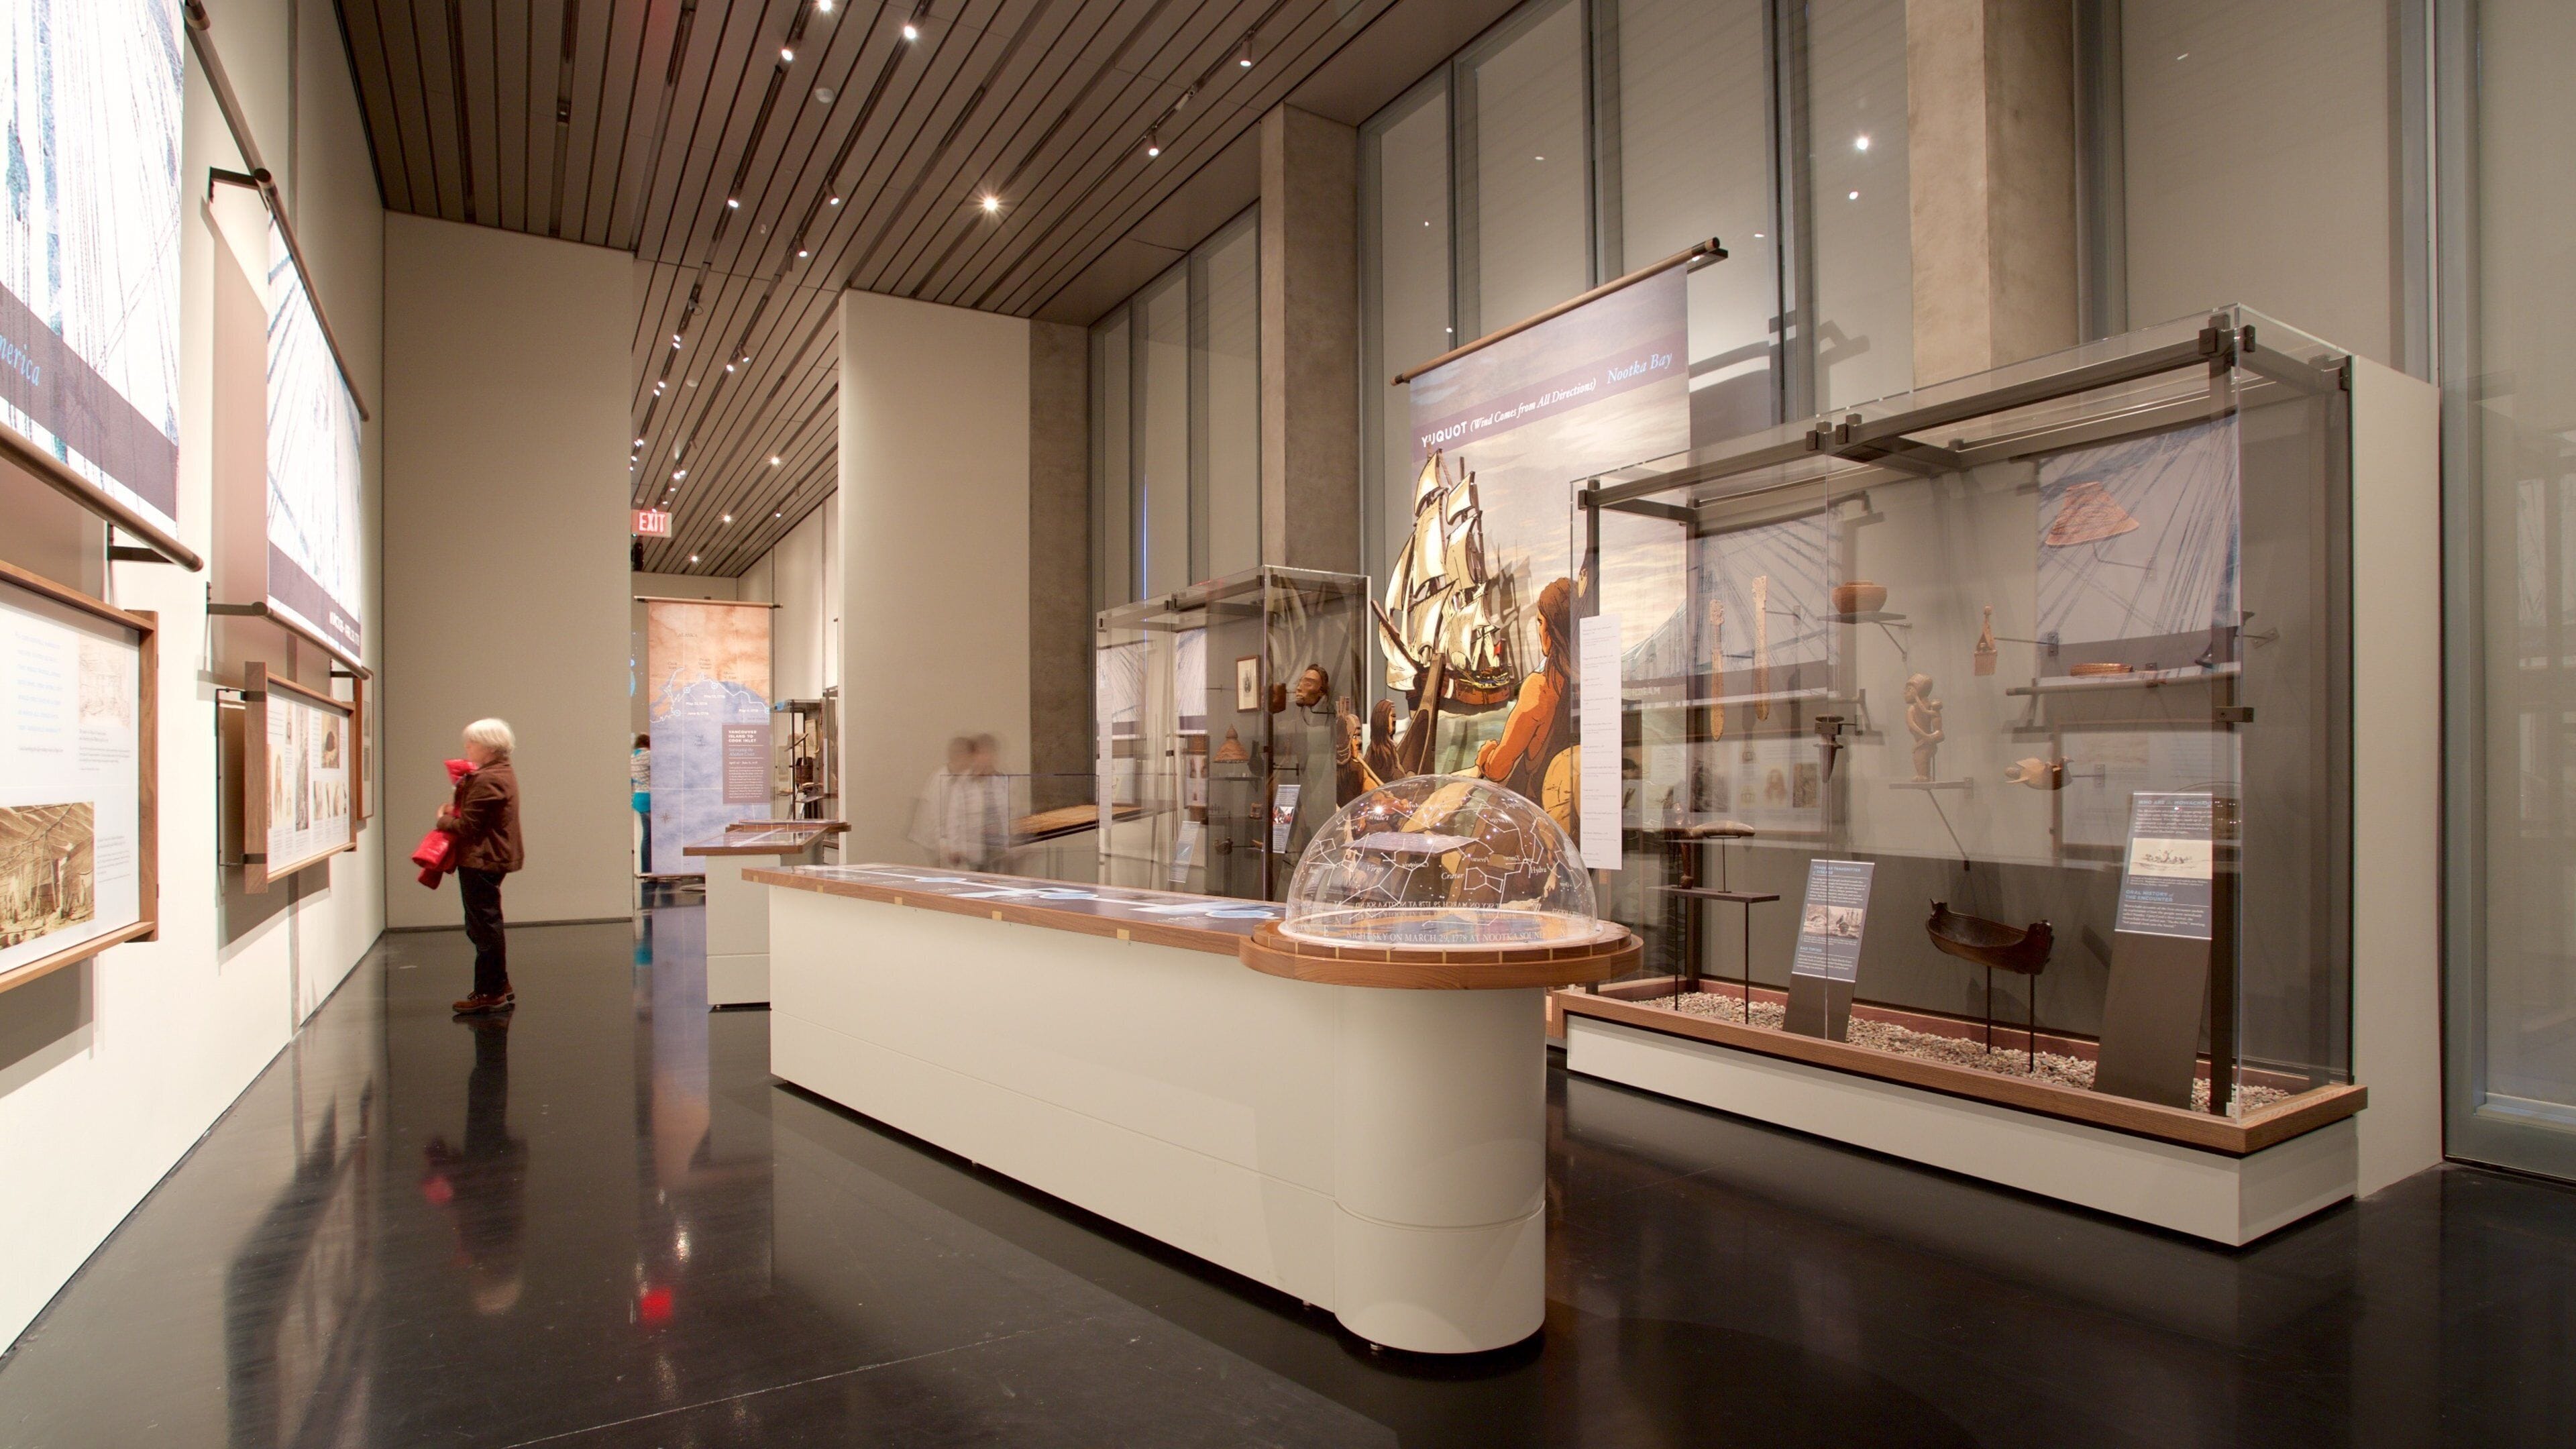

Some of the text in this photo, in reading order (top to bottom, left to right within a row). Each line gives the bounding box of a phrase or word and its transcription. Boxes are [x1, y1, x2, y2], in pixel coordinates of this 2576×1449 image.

[0, 333, 40, 386] merica
[1421, 352, 1672, 447] YUQUOT (Wind Comes from All Directions) Nootka Bay
[639, 512, 665, 533] EXIT
[1366, 863, 1384, 874] Virgo
[1530, 865, 1547, 875] Hydra
[1346, 930, 1372, 940] NIGHT
[1372, 933, 1387, 941] SKY
[1389, 933, 1403, 942] ON
[1404, 934, 1437, 942] MARCH
[1438, 934, 1450, 943] 29,
[1483, 932, 1519, 942] NOOTKA
[1519, 930, 1546, 941] SOUND
